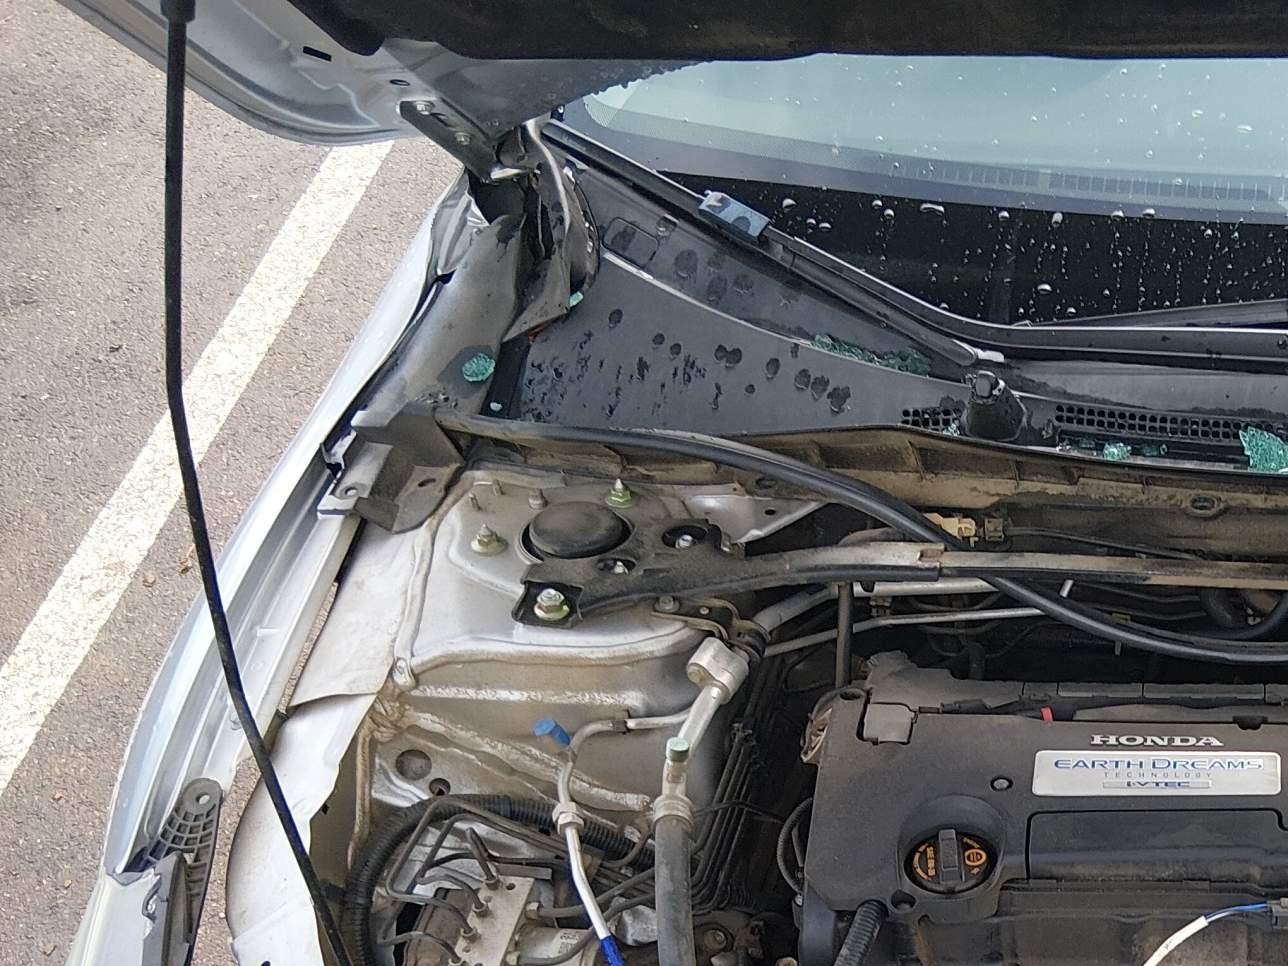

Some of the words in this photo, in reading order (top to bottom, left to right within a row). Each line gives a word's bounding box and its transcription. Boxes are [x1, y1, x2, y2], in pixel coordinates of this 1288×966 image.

[1090, 734, 1224, 746] HONDA
[1054, 758, 1144, 769] EARTH
[1151, 758, 1262, 769] DREAMS
